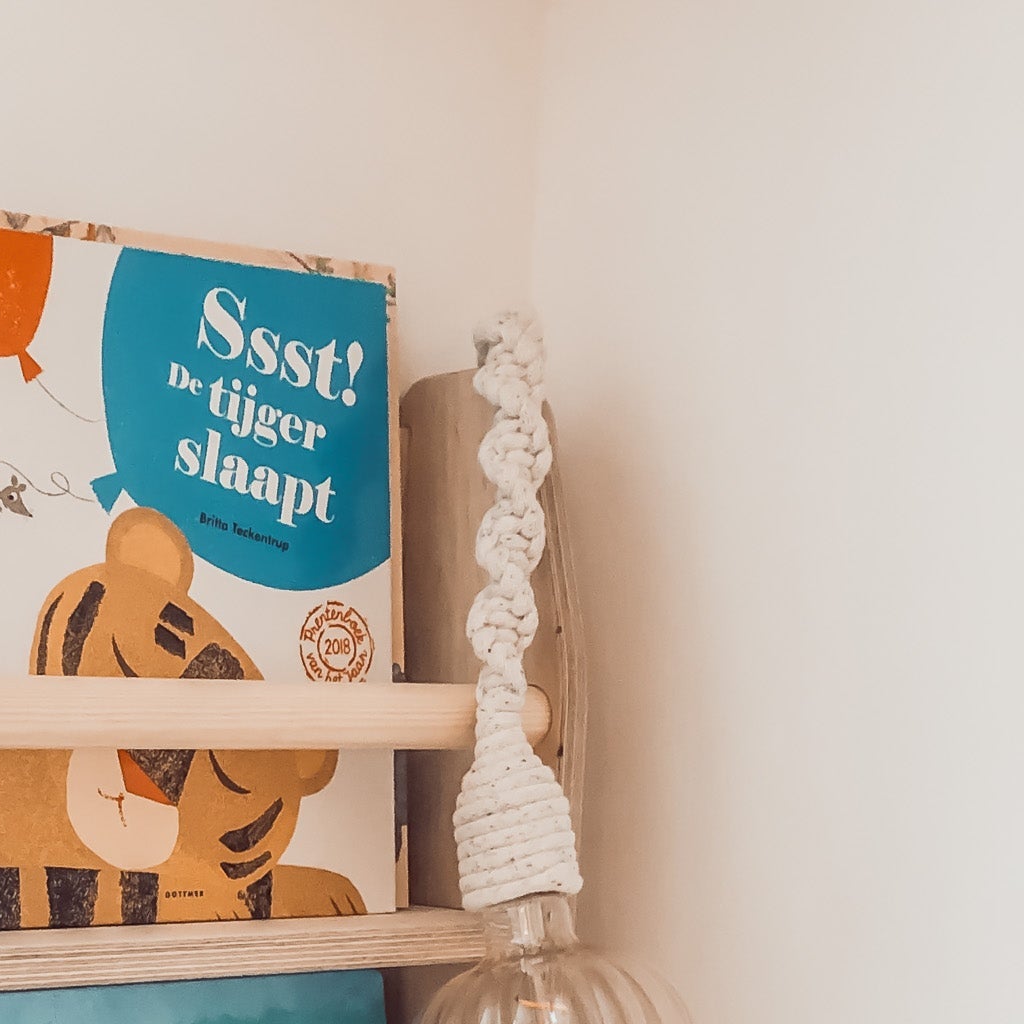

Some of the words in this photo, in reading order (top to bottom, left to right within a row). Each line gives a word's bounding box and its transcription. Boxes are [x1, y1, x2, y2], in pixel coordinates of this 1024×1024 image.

[197, 286, 364, 407] Ssst!
[167, 361, 204, 396] De
[208, 376, 327, 451] tijger
[174, 427, 337, 528] slaapt
[199, 511, 228, 531] Britta
[232, 521, 290, 552] Teckentrup
[324, 638, 351, 655] 2018
